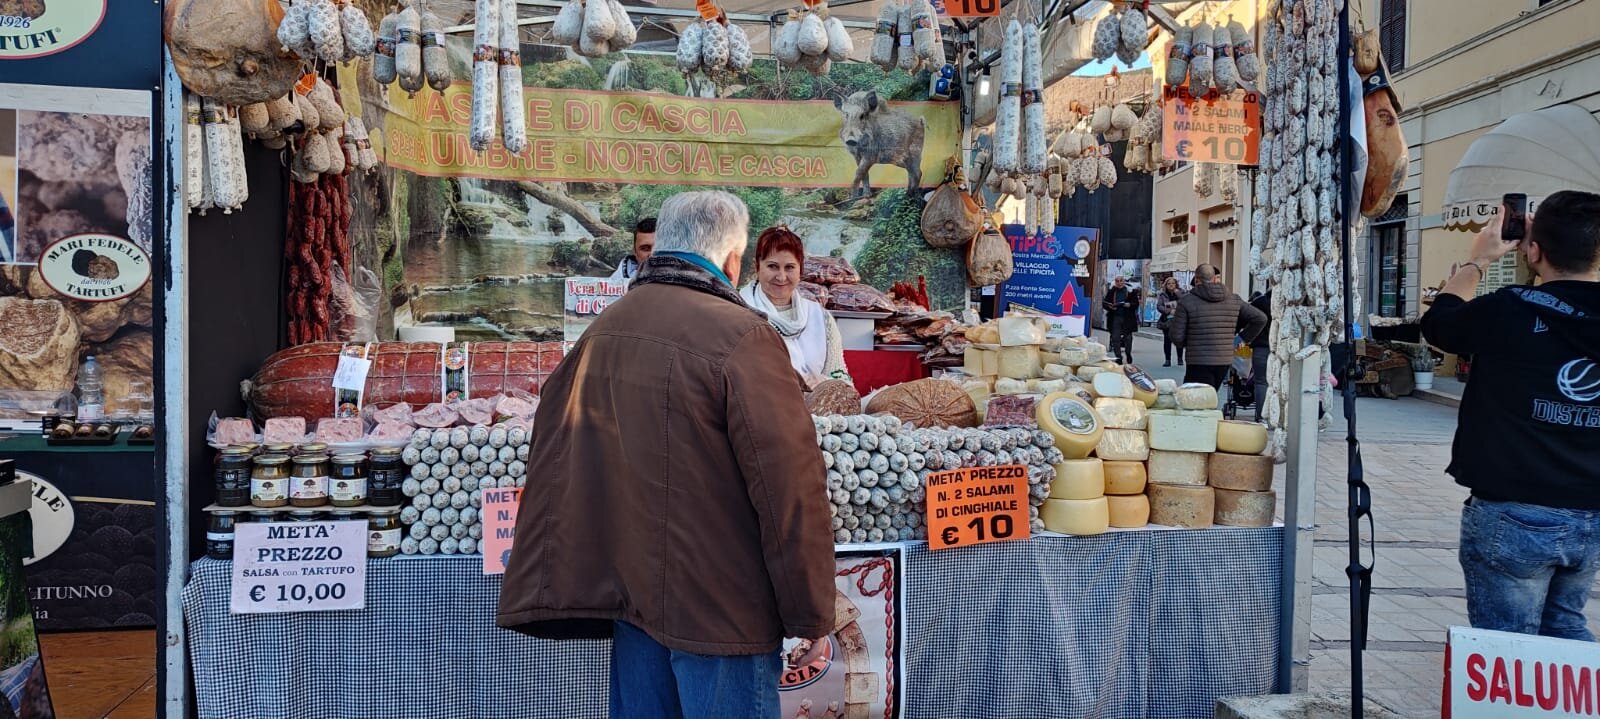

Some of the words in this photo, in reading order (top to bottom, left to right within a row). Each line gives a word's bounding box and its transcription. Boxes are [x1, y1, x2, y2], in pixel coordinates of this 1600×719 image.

[563, 99, 602, 132] DI
[611, 102, 747, 137] CASCIA
[1192, 105, 1200, 116] 2
[1204, 106, 1248, 119] SALAMI
[1173, 120, 1215, 134] MAIALE
[1218, 122, 1249, 135] NERO
[1176, 139, 1193, 158] €
[1202, 136, 1245, 161] 10
[585, 139, 716, 175] NORCIA
[718, 155, 735, 176] E
[739, 155, 829, 178] CASCIA
[48, 239, 83, 263] MARI
[88, 238, 144, 265] FEDELE
[1013, 267, 1028, 275] ELLE
[1015, 261, 1050, 270] VILLAGGIO
[66, 282, 125, 297] TARTUFI
[575, 298, 591, 314] di
[970, 467, 1025, 481] PREZZO
[937, 491, 951, 502] N.
[954, 489, 963, 500] 2
[966, 484, 1015, 498] SALAMI
[497, 510, 514, 522] N.
[936, 508, 948, 519] DI
[951, 500, 1018, 517] CINGHIALE
[941, 526, 960, 546] €
[967, 514, 1014, 541] 10
[256, 545, 343, 562] PREZZO
[242, 568, 280, 578] SALSA
[282, 569, 298, 577] con
[300, 565, 355, 577] TARTUFO
[249, 584, 266, 603] €
[276, 582, 346, 605] 10,00
